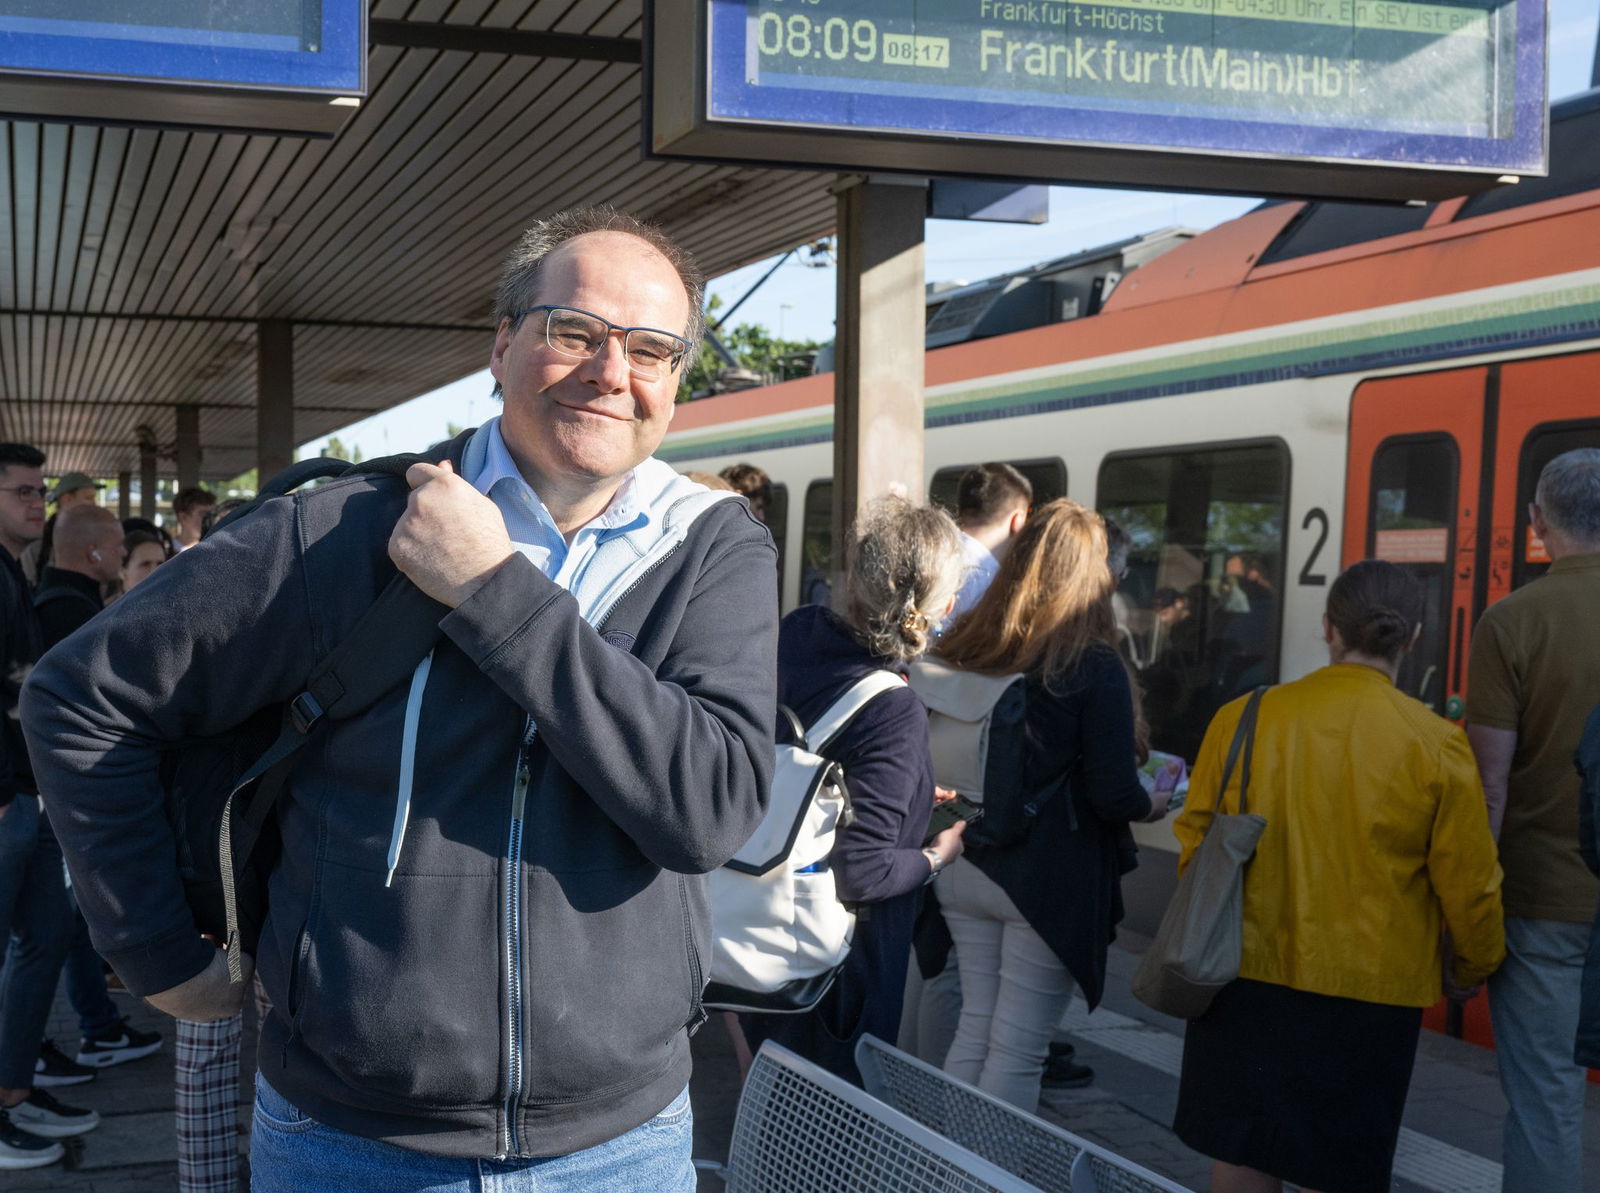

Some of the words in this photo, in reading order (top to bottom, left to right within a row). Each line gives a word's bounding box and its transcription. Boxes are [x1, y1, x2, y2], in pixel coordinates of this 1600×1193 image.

[758, 12, 878, 62] 08:09
[887, 41, 945, 62] 08:17
[980, 0, 1165, 33] Frankfurt-Höchst
[1338, 1, 1368, 23] En
[1374, 3, 1410, 25] SEV
[1415, 7, 1443, 29] ist
[980, 29, 1361, 98] Frankfurt(Main)Hbf
[1299, 507, 1329, 586] 2
